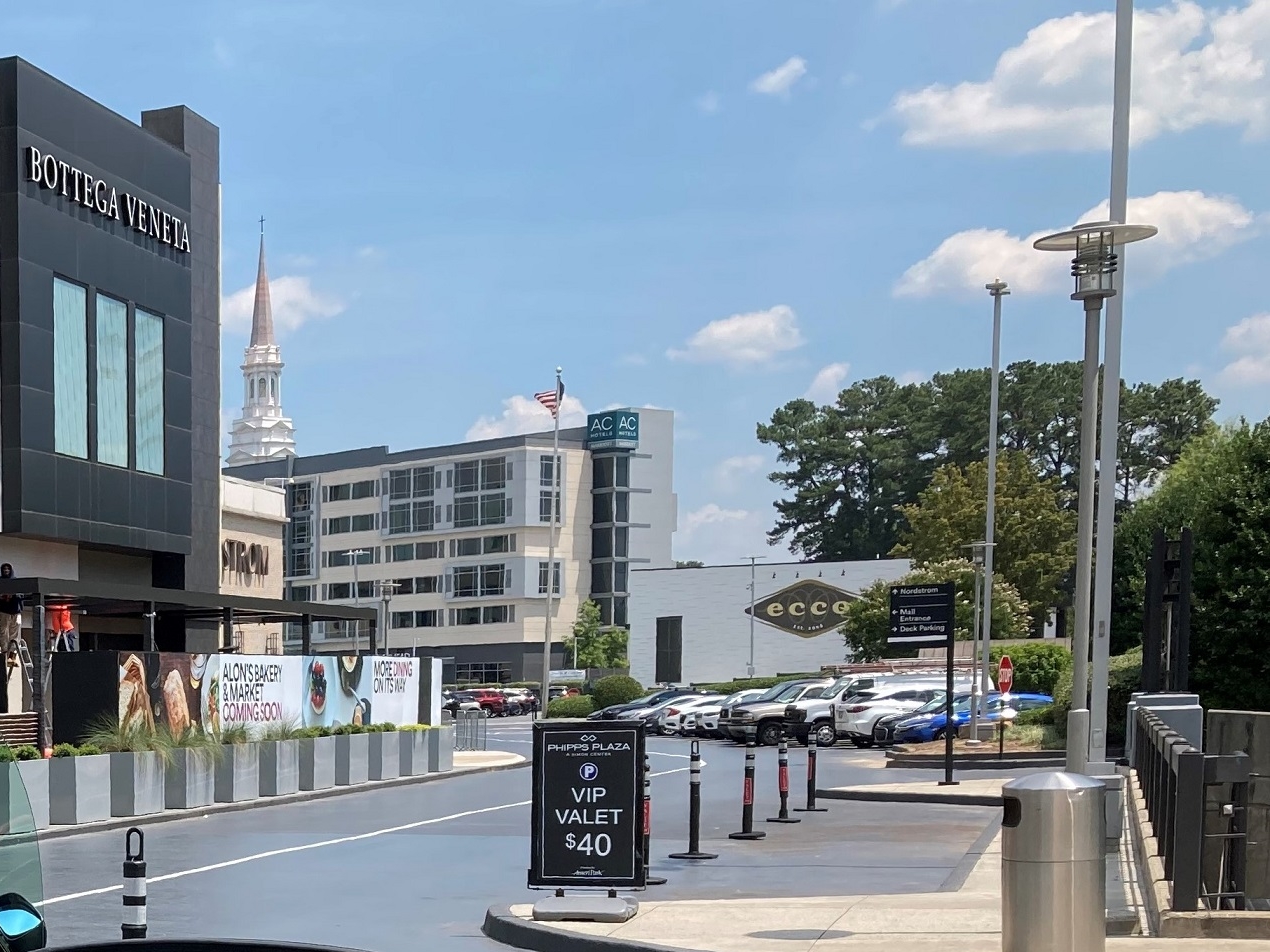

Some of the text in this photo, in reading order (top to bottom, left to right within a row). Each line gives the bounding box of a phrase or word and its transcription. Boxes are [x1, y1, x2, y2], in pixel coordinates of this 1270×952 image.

[29, 146, 191, 253] BOTTEGA VENETA
[590, 416, 613, 432] AC
[619, 415, 637, 431] AC
[900, 587, 939, 595] Nordstrom
[766, 600, 850, 617] ecco
[920, 624, 946, 632] Parking
[222, 662, 282, 683] ALON'S BAKERY
[373, 660, 413, 678] MORE DINING
[1000, 667, 1012, 682] STOP
[222, 683, 265, 702] & MARKET
[373, 677, 407, 694] ON ITS WAY
[222, 701, 283, 722] COMING SOON
[547, 742, 631, 752] PHIPPS PLAZA
[571, 787, 607, 803] VIP
[555, 808, 623, 825] VALET
[565, 832, 612, 857] $40
